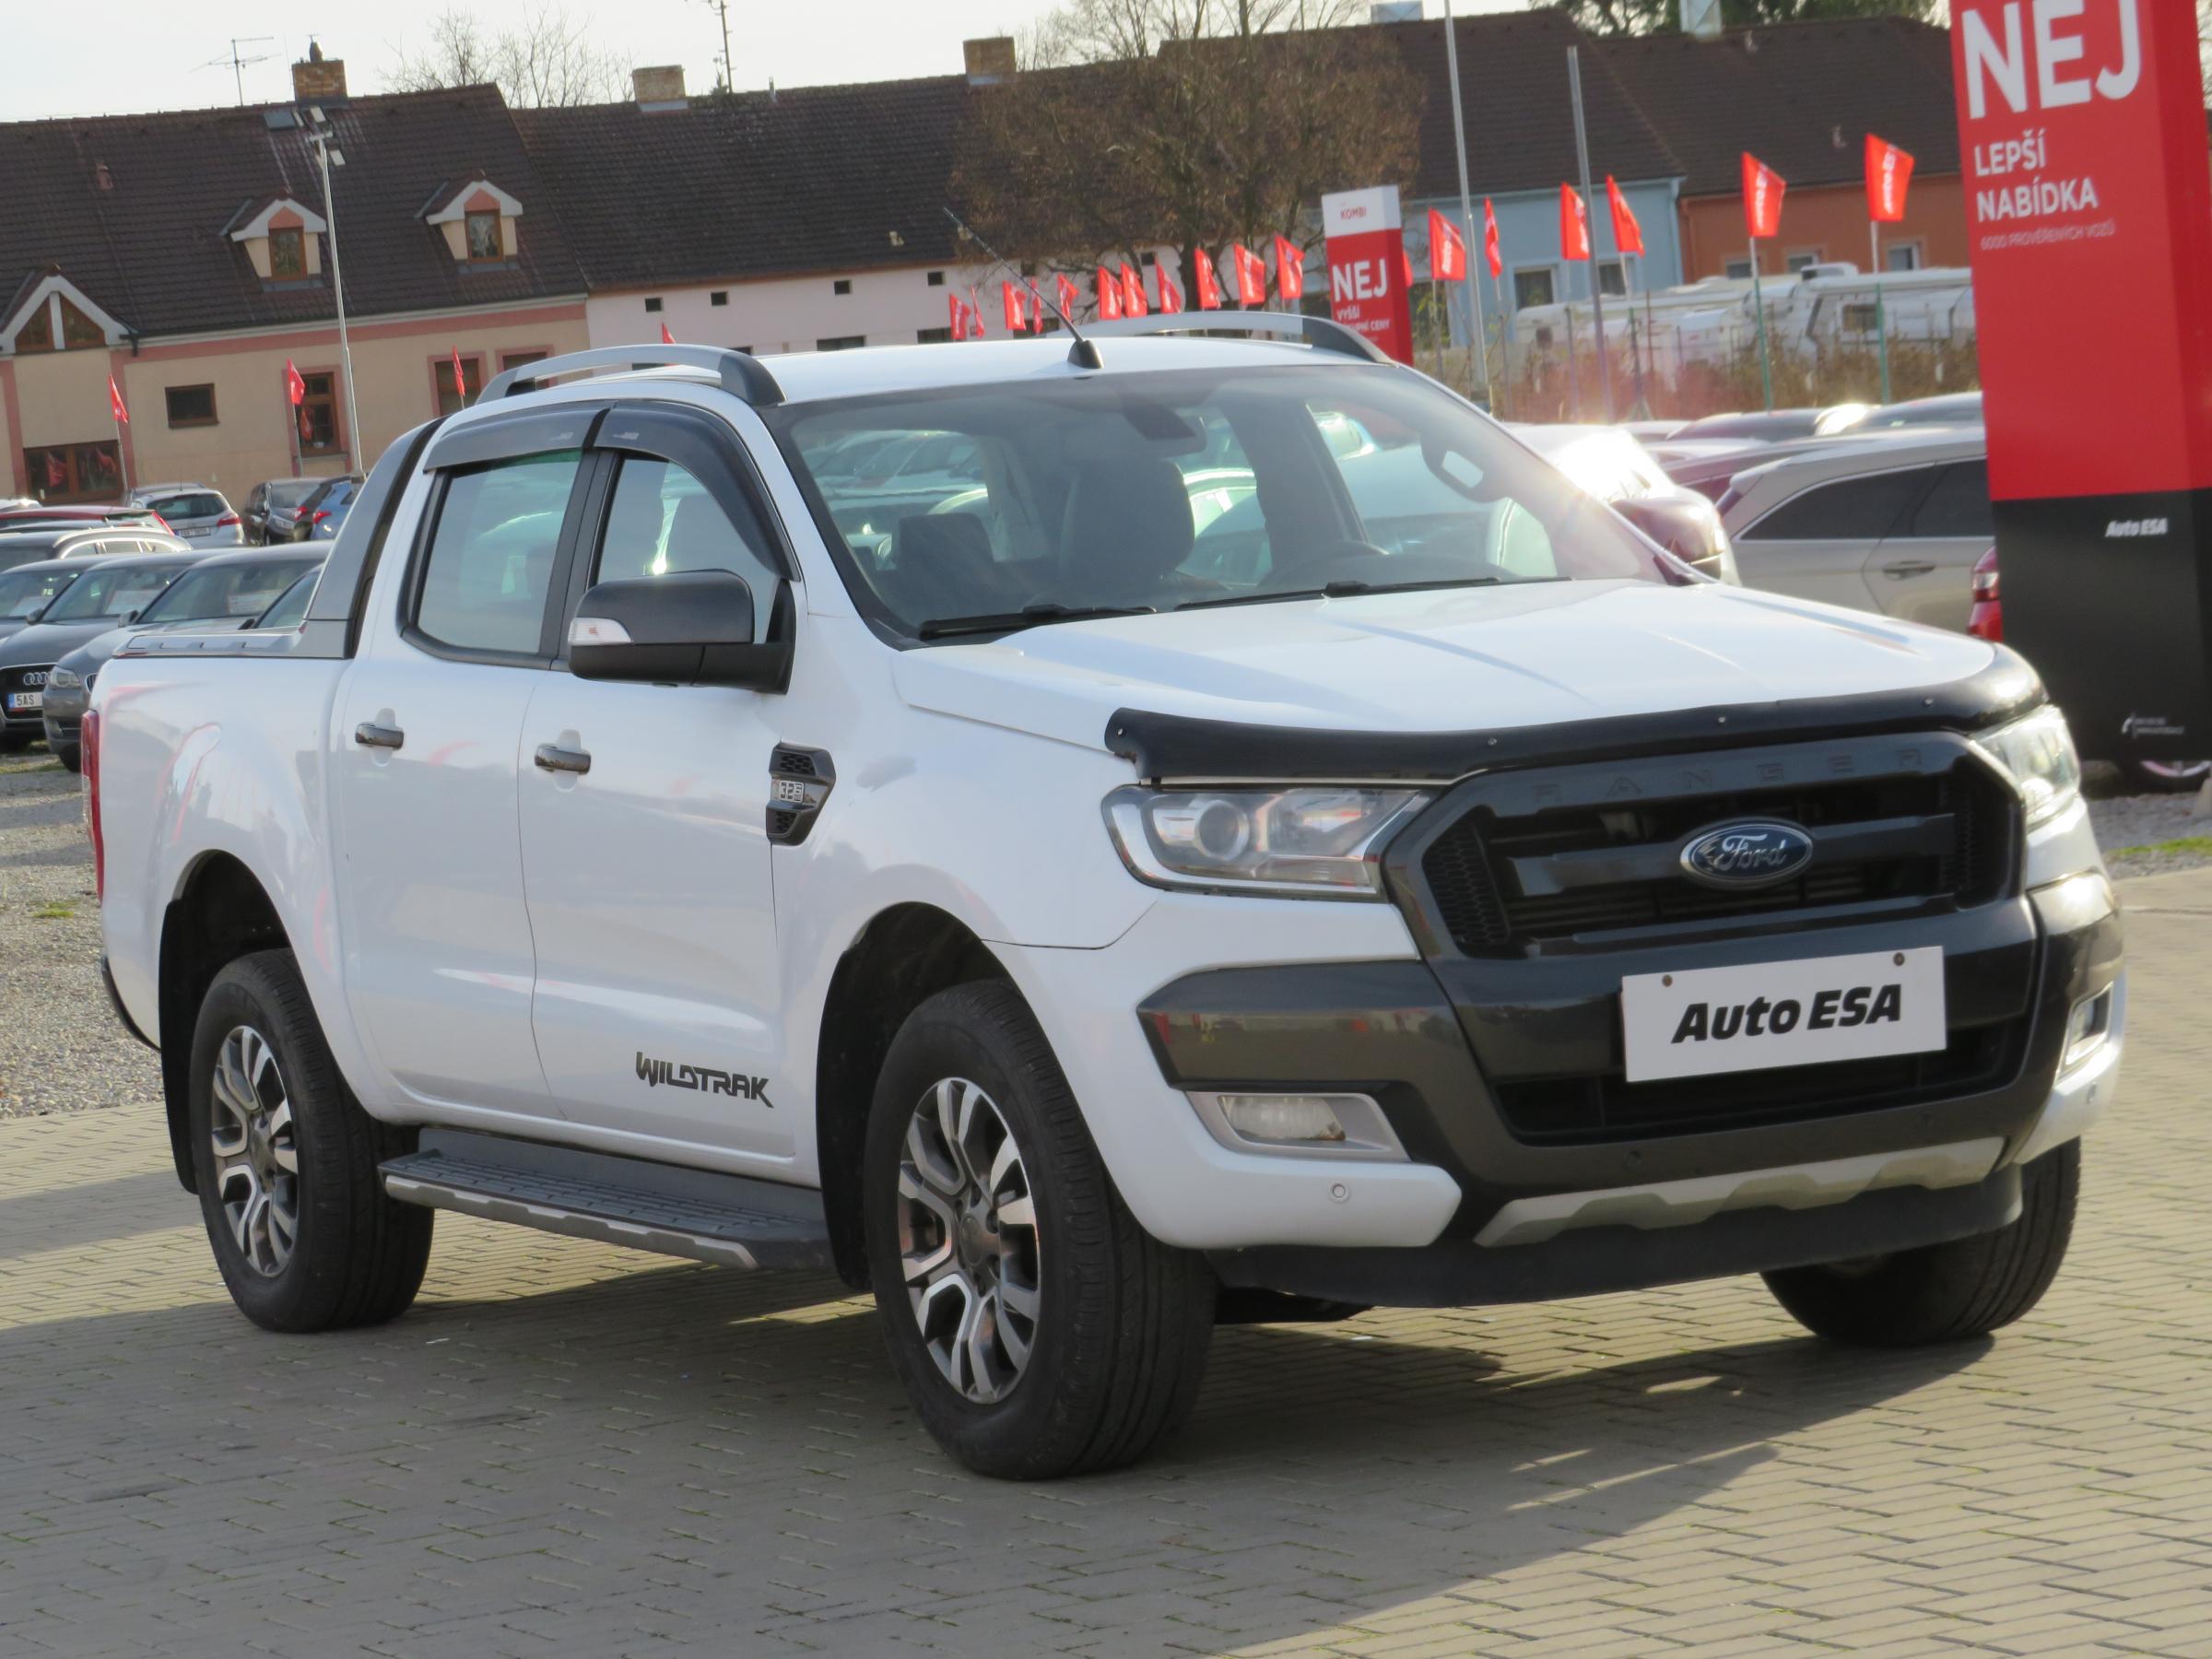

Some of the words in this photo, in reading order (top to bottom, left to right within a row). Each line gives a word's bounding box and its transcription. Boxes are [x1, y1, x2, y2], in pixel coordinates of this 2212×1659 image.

[1961, 0, 2141, 119] NEJ
[1974, 128, 2046, 177] LEPŠÍ
[1976, 177, 2099, 222] NABÍDKA
[1332, 258, 1388, 302] NEJ
[1533, 748, 1923, 804] RANGER
[1712, 833, 1788, 871] Ford
[1671, 996, 1801, 1044] Auto
[1806, 983, 1901, 1030] ESA
[636, 1052, 774, 1108] WILDTRAK
